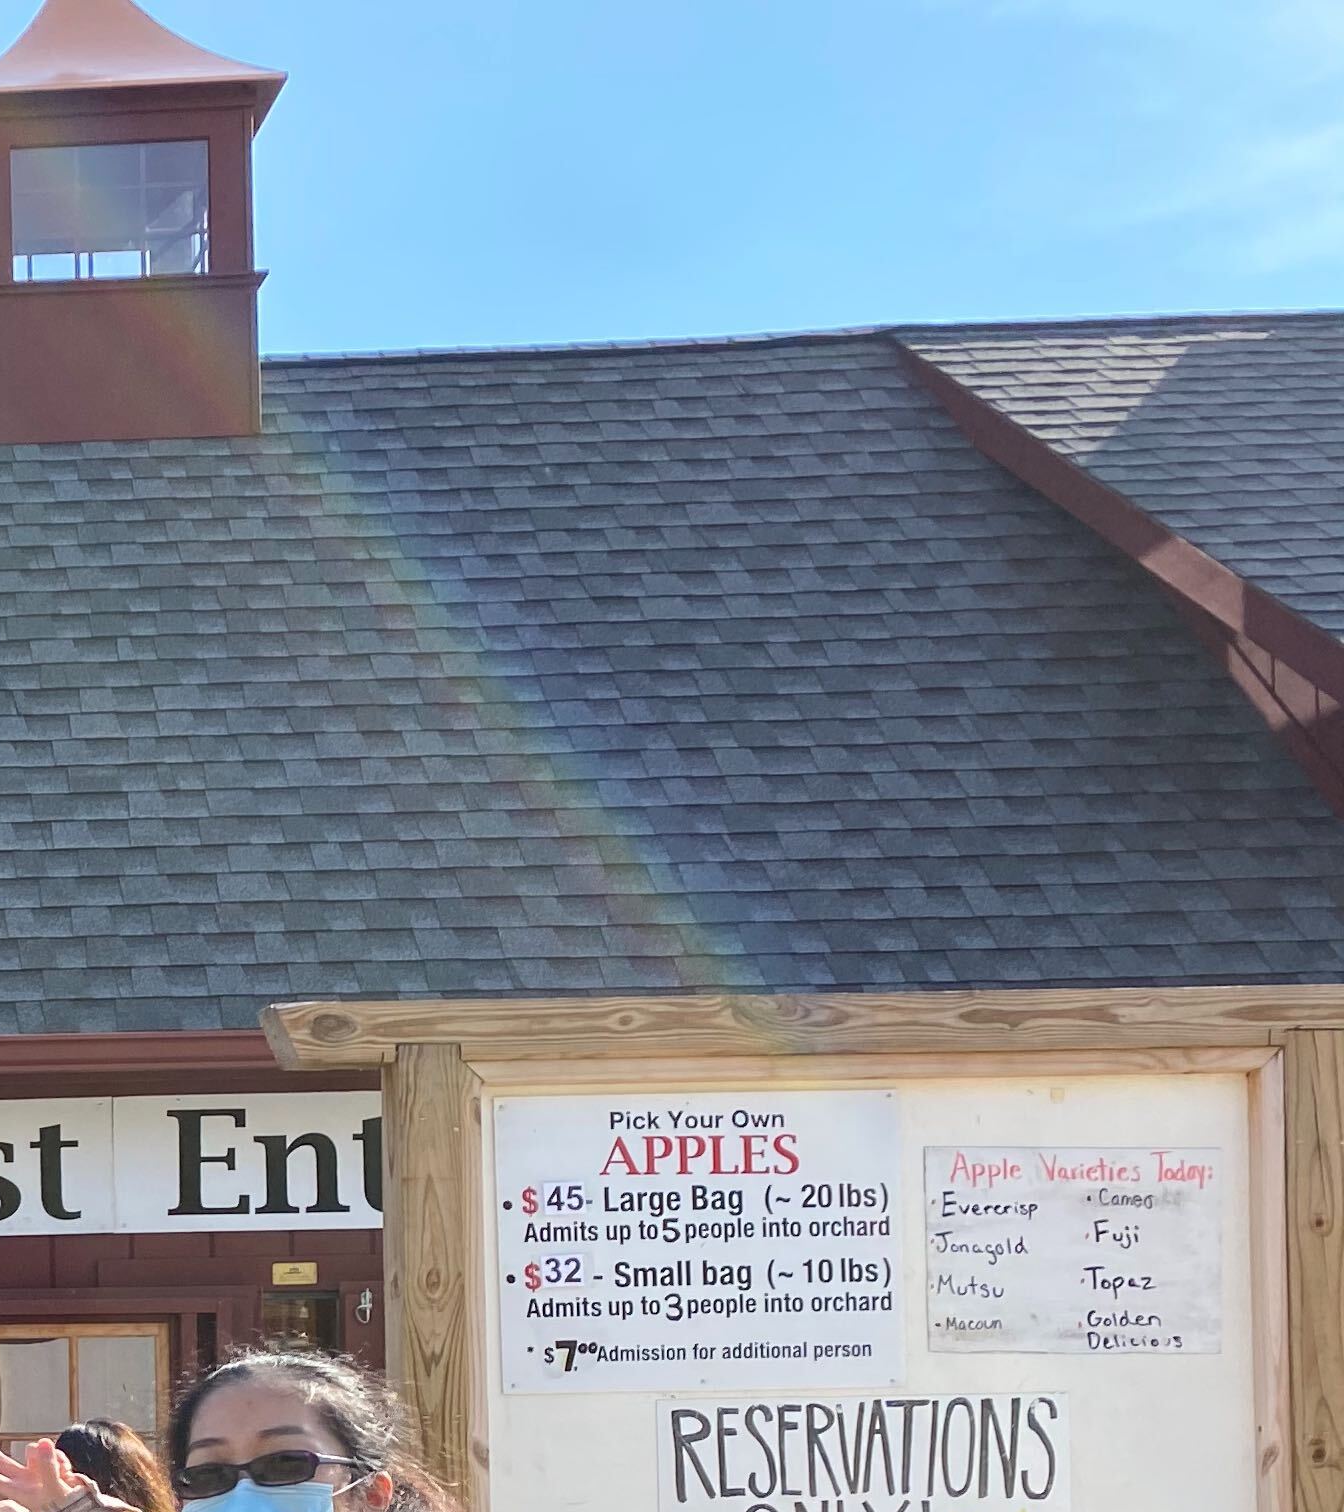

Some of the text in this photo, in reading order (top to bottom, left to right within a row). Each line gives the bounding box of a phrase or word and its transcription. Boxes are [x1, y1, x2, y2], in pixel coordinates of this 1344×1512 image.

[609, 1110, 784, 1129] Pick Your Own
[599, 1134, 800, 1176] APPLES
[950, 1151, 1022, 1188] Apple
[1039, 1153, 1141, 1182] Varieties
[604, 1186, 681, 1217] Large
[692, 1185, 744, 1215] Bag
[941, 1191, 1038, 1220] Evercrisp
[524, 1216, 890, 1244] Admits up to 5 people into orchard
[1094, 1219, 1140, 1249] Fuji
[935, 1231, 1028, 1266] Jonagold
[614, 1260, 691, 1288] Small
[702, 1261, 752, 1290] bag
[936, 1274, 1004, 1299] Mutsu
[1083, 1266, 1156, 1299] Topaz
[527, 1292, 892, 1321] Admits up to 3 people into orchard
[1086, 1310, 1162, 1328] Golden
[946, 1316, 1002, 1330] Macoun
[597, 1344, 686, 1362] Admission
[693, 1344, 714, 1360] for
[722, 1342, 807, 1359] additional
[814, 1342, 872, 1362] person
[670, 1396, 1058, 1502] RESERVATIONS
